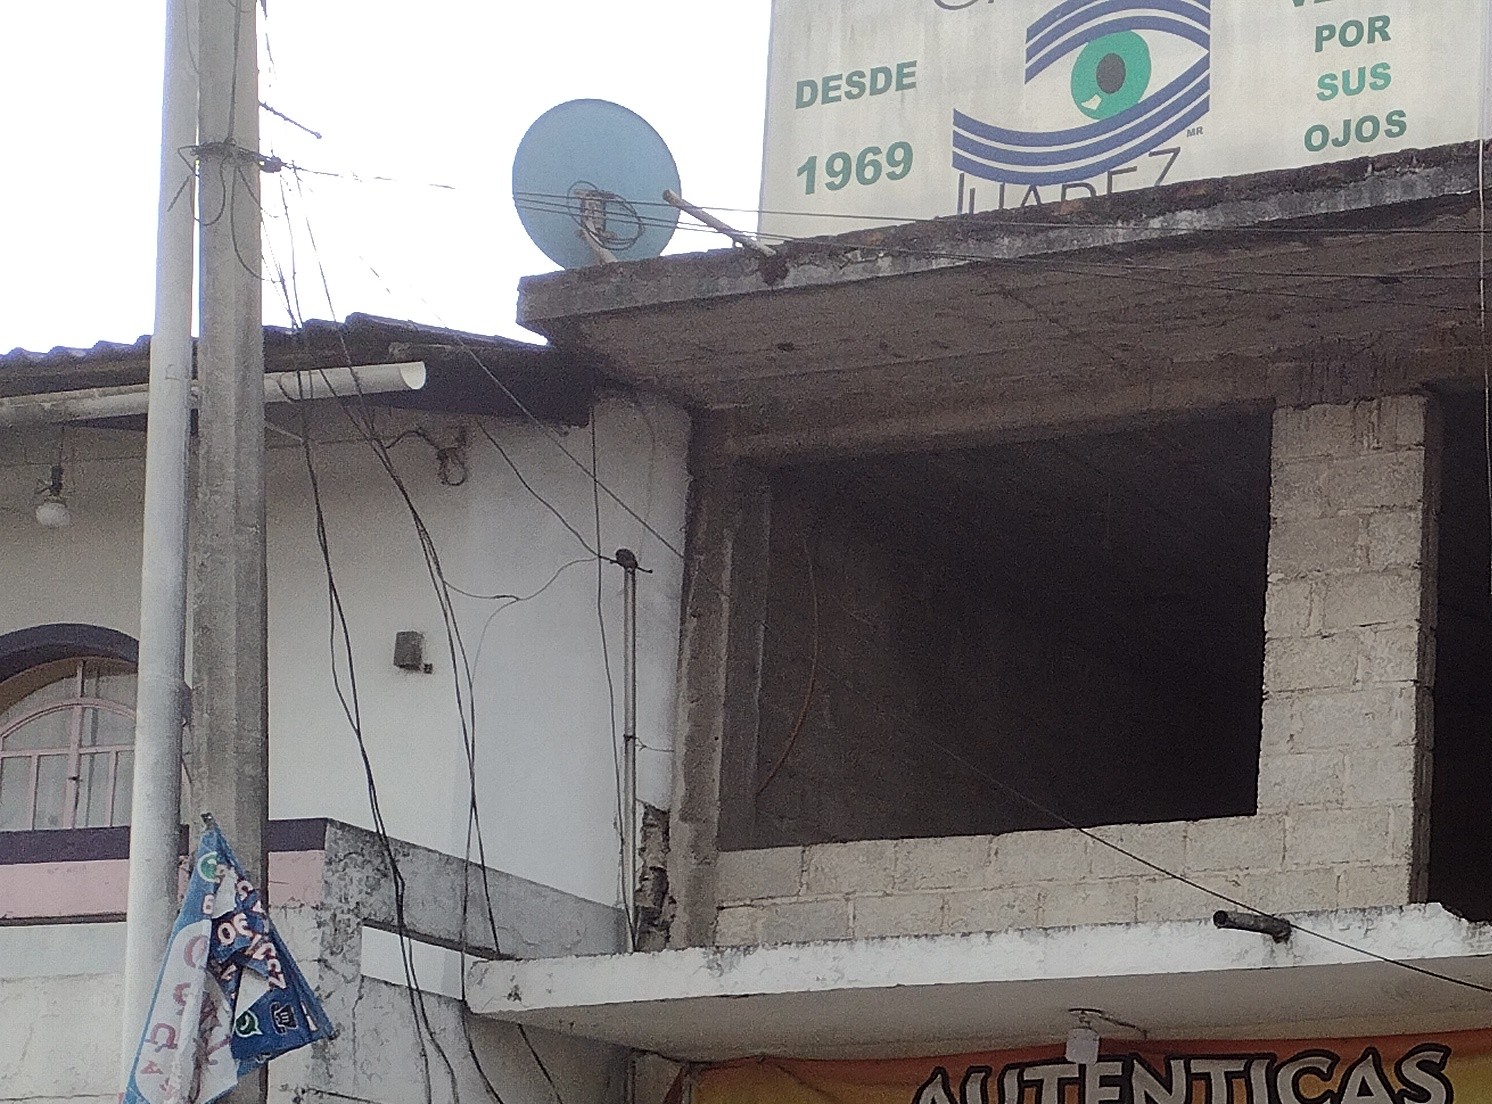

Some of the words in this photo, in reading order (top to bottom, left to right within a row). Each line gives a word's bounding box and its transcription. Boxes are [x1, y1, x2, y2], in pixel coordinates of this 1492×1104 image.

[1314, 15, 1392, 53] POR
[795, 60, 918, 110] DESDE
[1316, 62, 1392, 101] SUS
[1186, 126, 1204, 138] MR
[1303, 110, 1408, 152] OJOS
[796, 141, 914, 195] 1969
